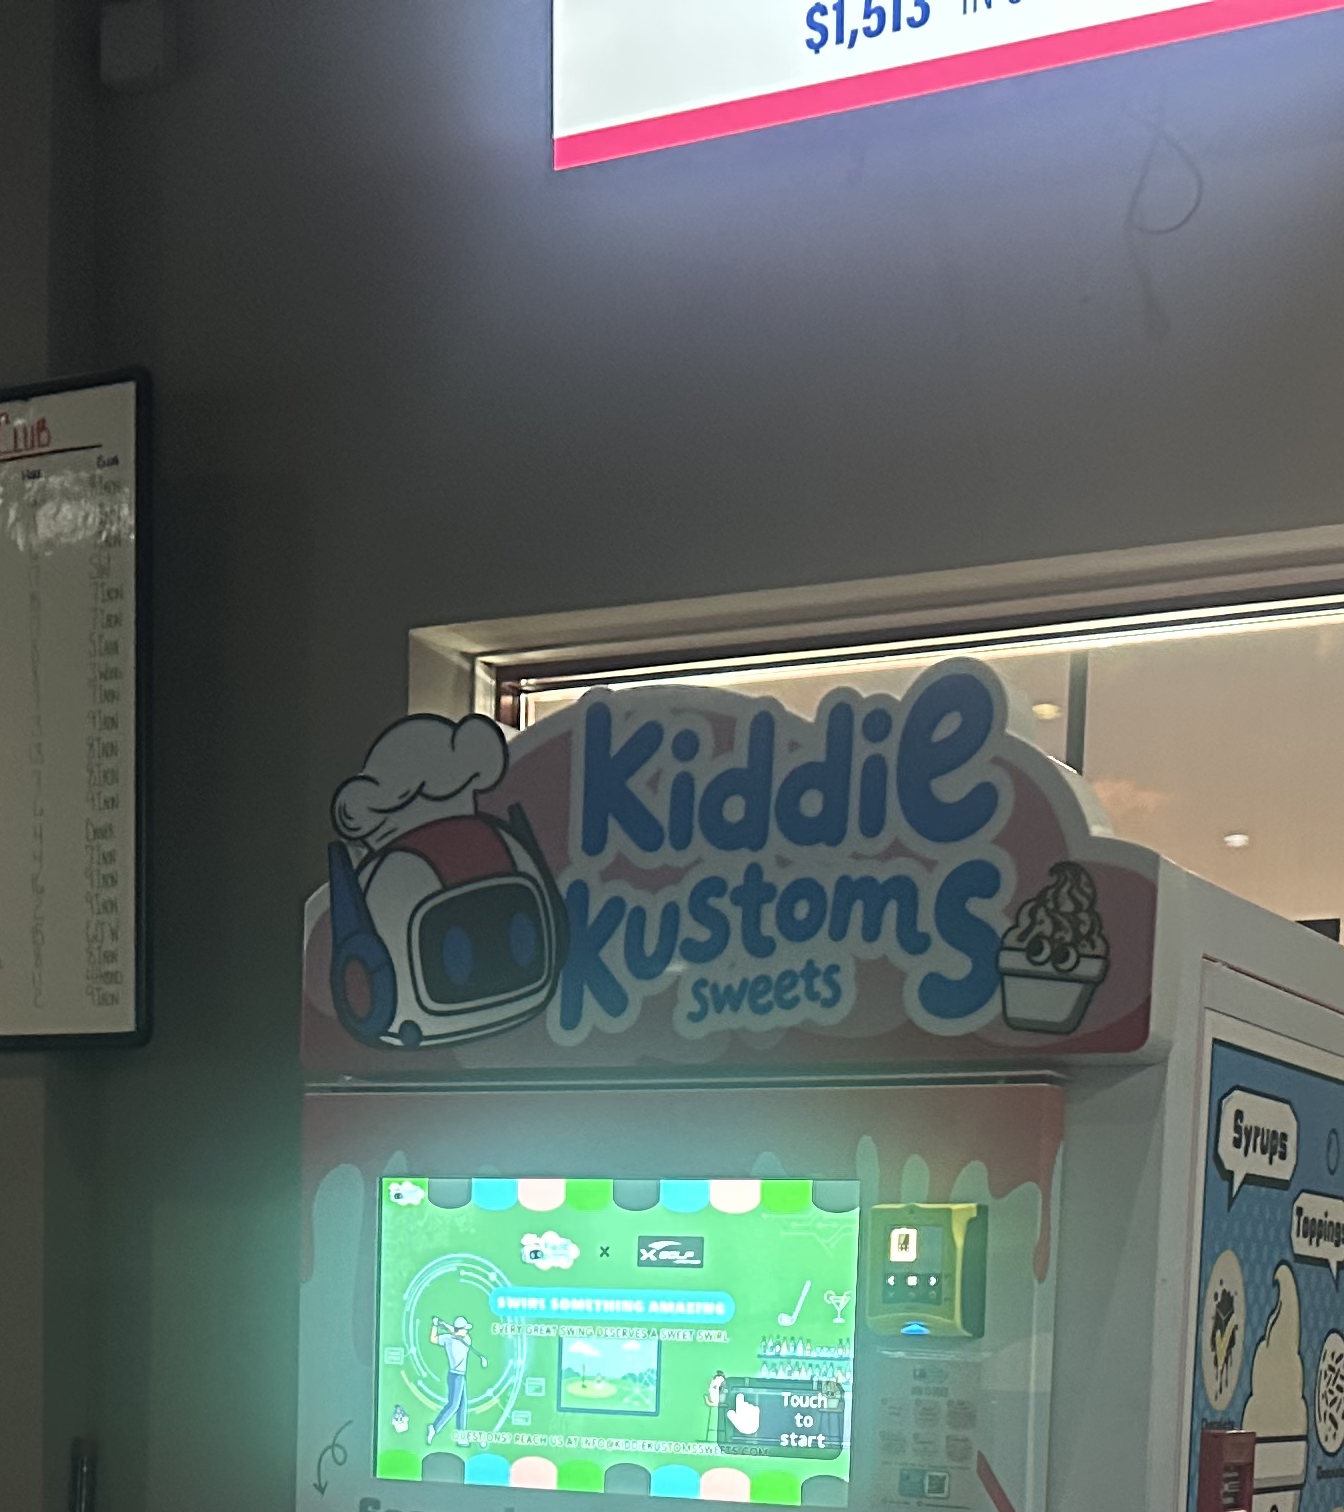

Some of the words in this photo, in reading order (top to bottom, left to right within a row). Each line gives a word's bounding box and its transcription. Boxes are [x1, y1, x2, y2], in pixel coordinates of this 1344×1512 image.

[580, 672, 999, 858] Kiddie
[1232, 1108, 1289, 1166] Syrups
[497, 1296, 545, 1310] SWIRL
[550, 1297, 644, 1312] SOMETHING
[648, 1300, 726, 1315] AMAZING
[492, 1323, 523, 1335] EVERY
[525, 1325, 557, 1336] GREAT
[560, 1326, 593, 1337] SWING
[660, 1329, 694, 1340] SWEET
[697, 1331, 729, 1342] SWIRL
[781, 1392, 829, 1410] Touch
[794, 1411, 814, 1428] to
[779, 1431, 826, 1449] start
